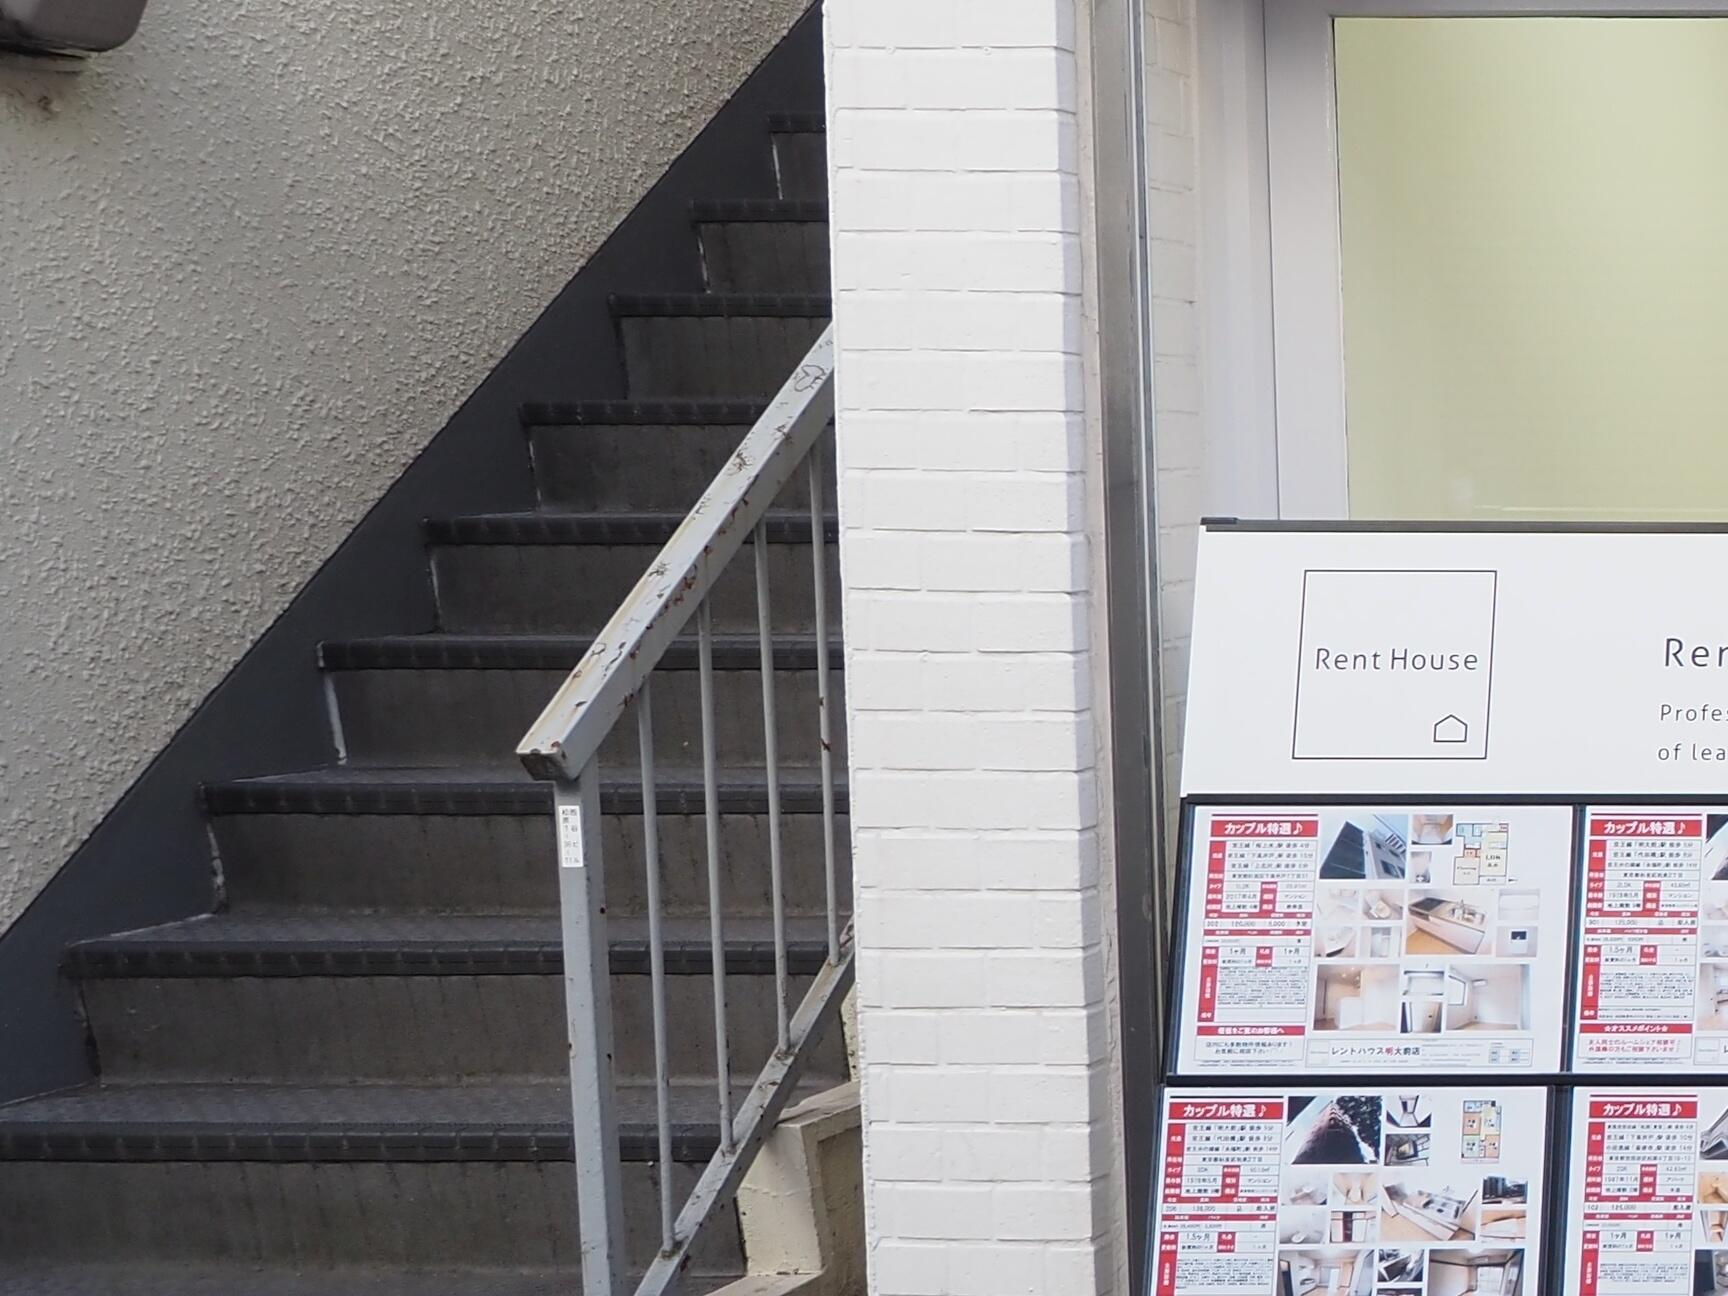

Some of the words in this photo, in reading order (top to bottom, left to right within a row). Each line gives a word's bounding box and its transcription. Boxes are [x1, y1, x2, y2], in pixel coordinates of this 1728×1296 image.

[1315, 647, 1381, 670] Rent
[1391, 648, 1478, 671] House
[1658, 743, 1682, 761] of
